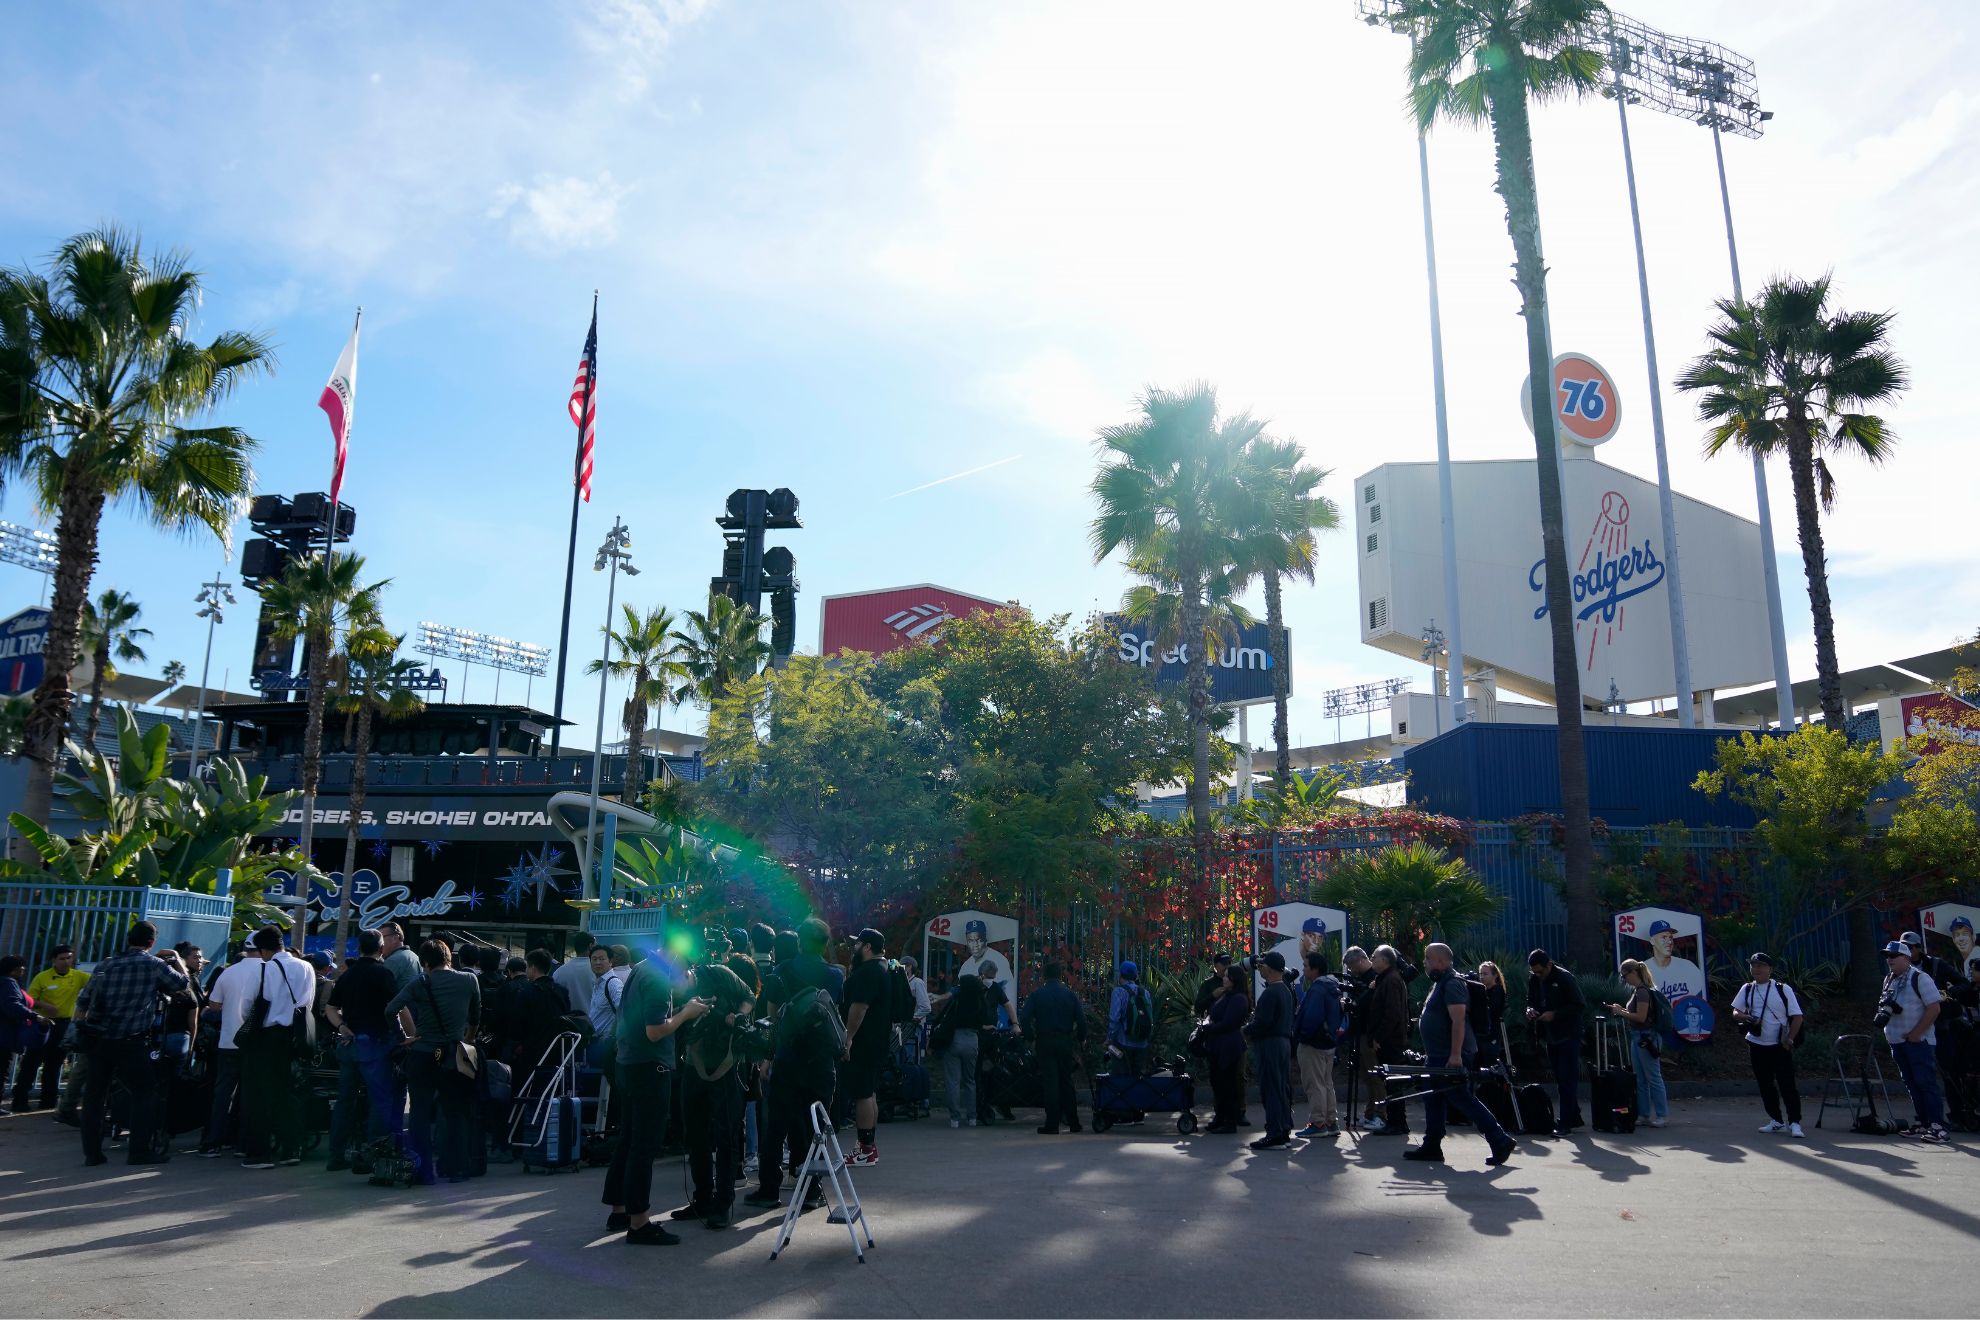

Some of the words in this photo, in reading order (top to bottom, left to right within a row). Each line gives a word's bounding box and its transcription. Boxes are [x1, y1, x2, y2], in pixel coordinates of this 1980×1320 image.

[1559, 378, 1606, 421] 76
[386, 811, 477, 825] SHOHEI
[483, 811, 553, 826] OHTA
[270, 881, 372, 898] BUE
[359, 880, 471, 932] Earth
[930, 918, 951, 936] 42
[1259, 911, 1278, 928] 49
[1619, 916, 1635, 932] 25
[1924, 911, 1936, 928] 41
[1660, 980, 1690, 1002] dgers
